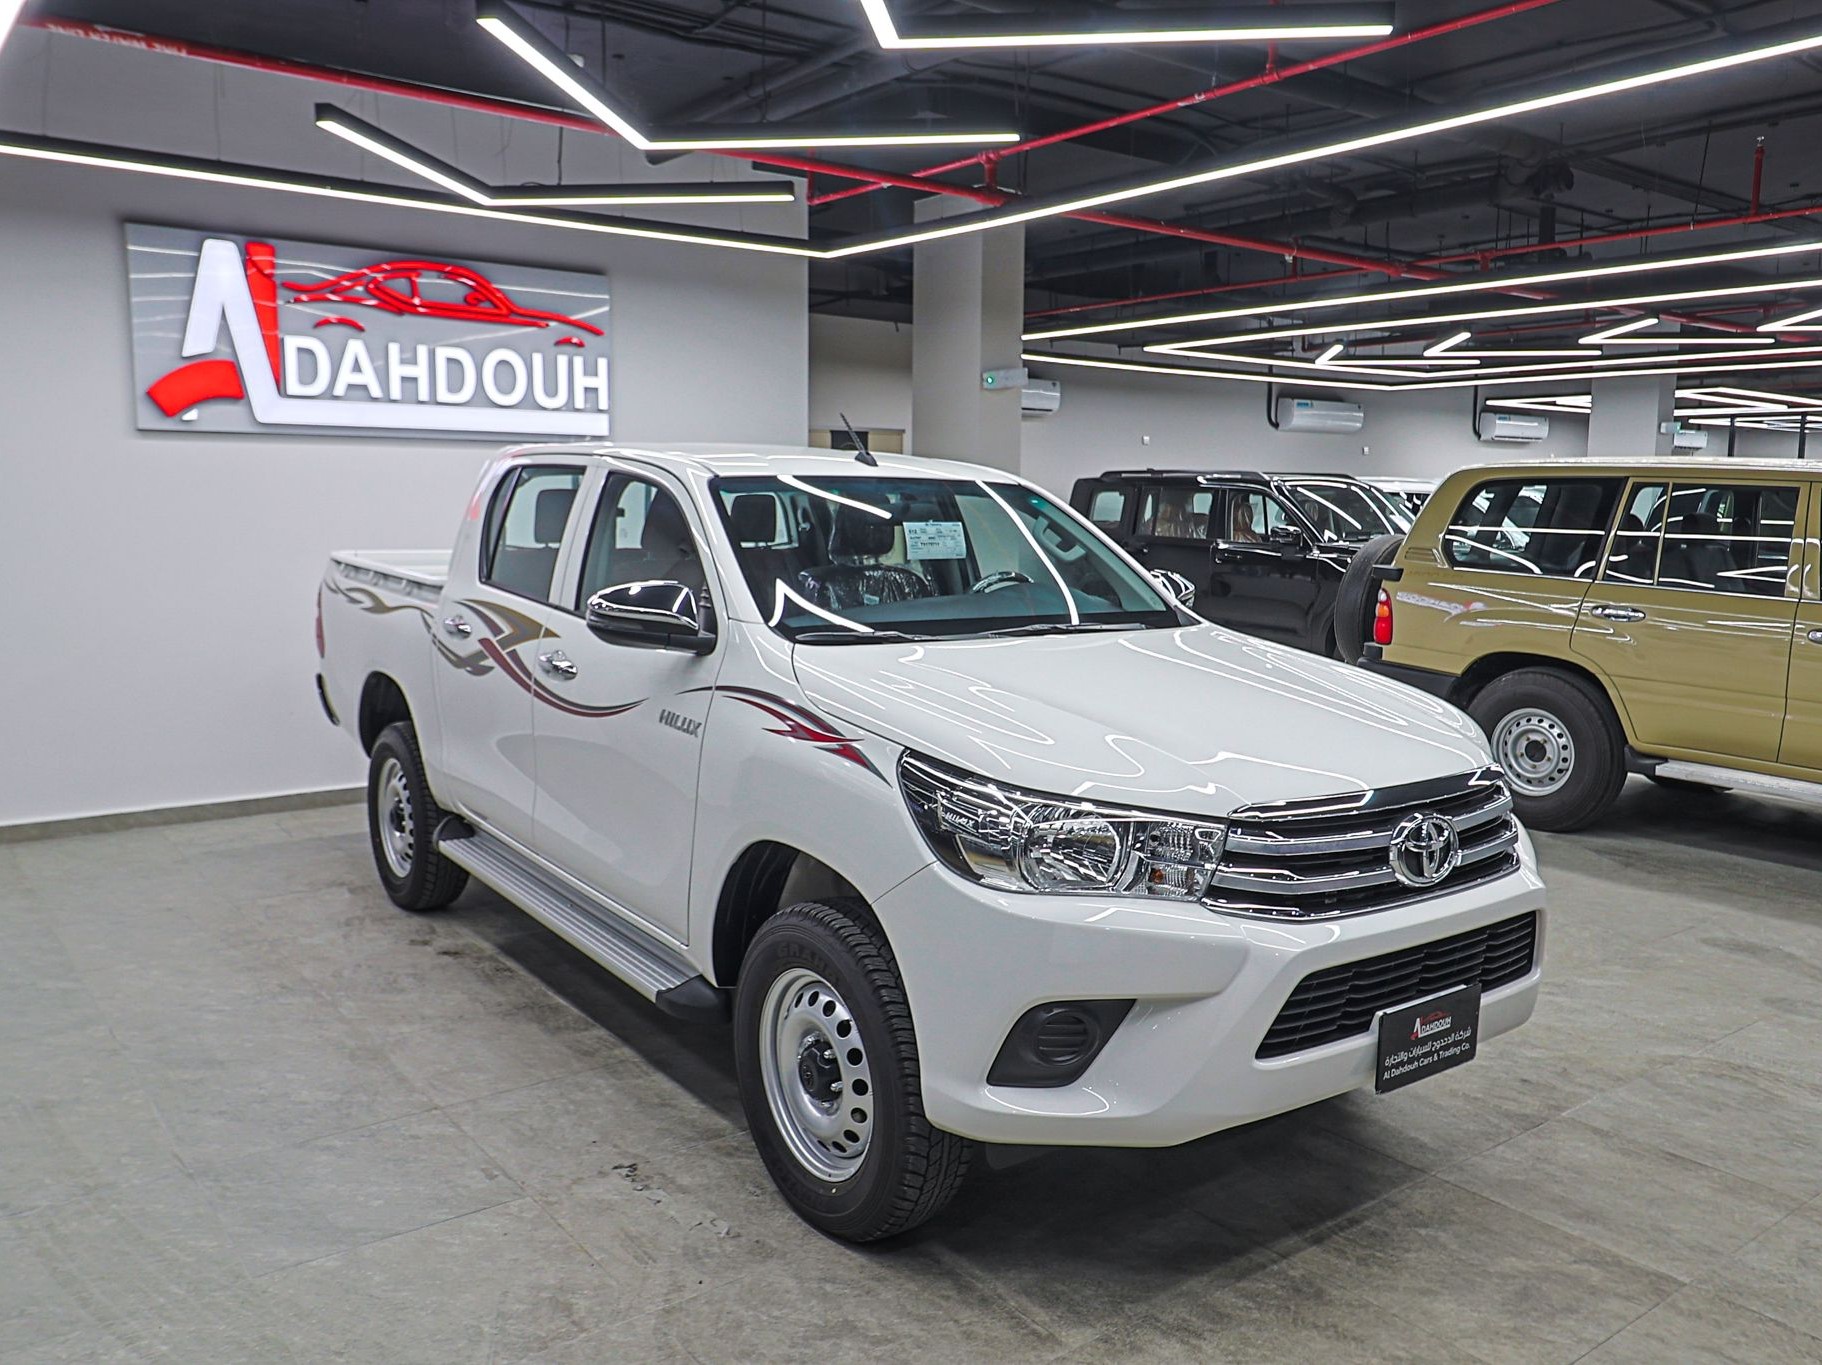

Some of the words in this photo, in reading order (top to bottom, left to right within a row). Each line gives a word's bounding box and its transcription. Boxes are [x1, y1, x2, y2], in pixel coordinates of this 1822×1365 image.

[659, 709, 702, 738] HILUX
[1454, 1026, 1472, 1041] شركة
[1391, 1061, 1419, 1077] Dahdouh
[1419, 1056, 1433, 1066] Cars
[1433, 1053, 1438, 1062] &
[1439, 1046, 1461, 1059] Trading
[1461, 1042, 1471, 1050] Co.
